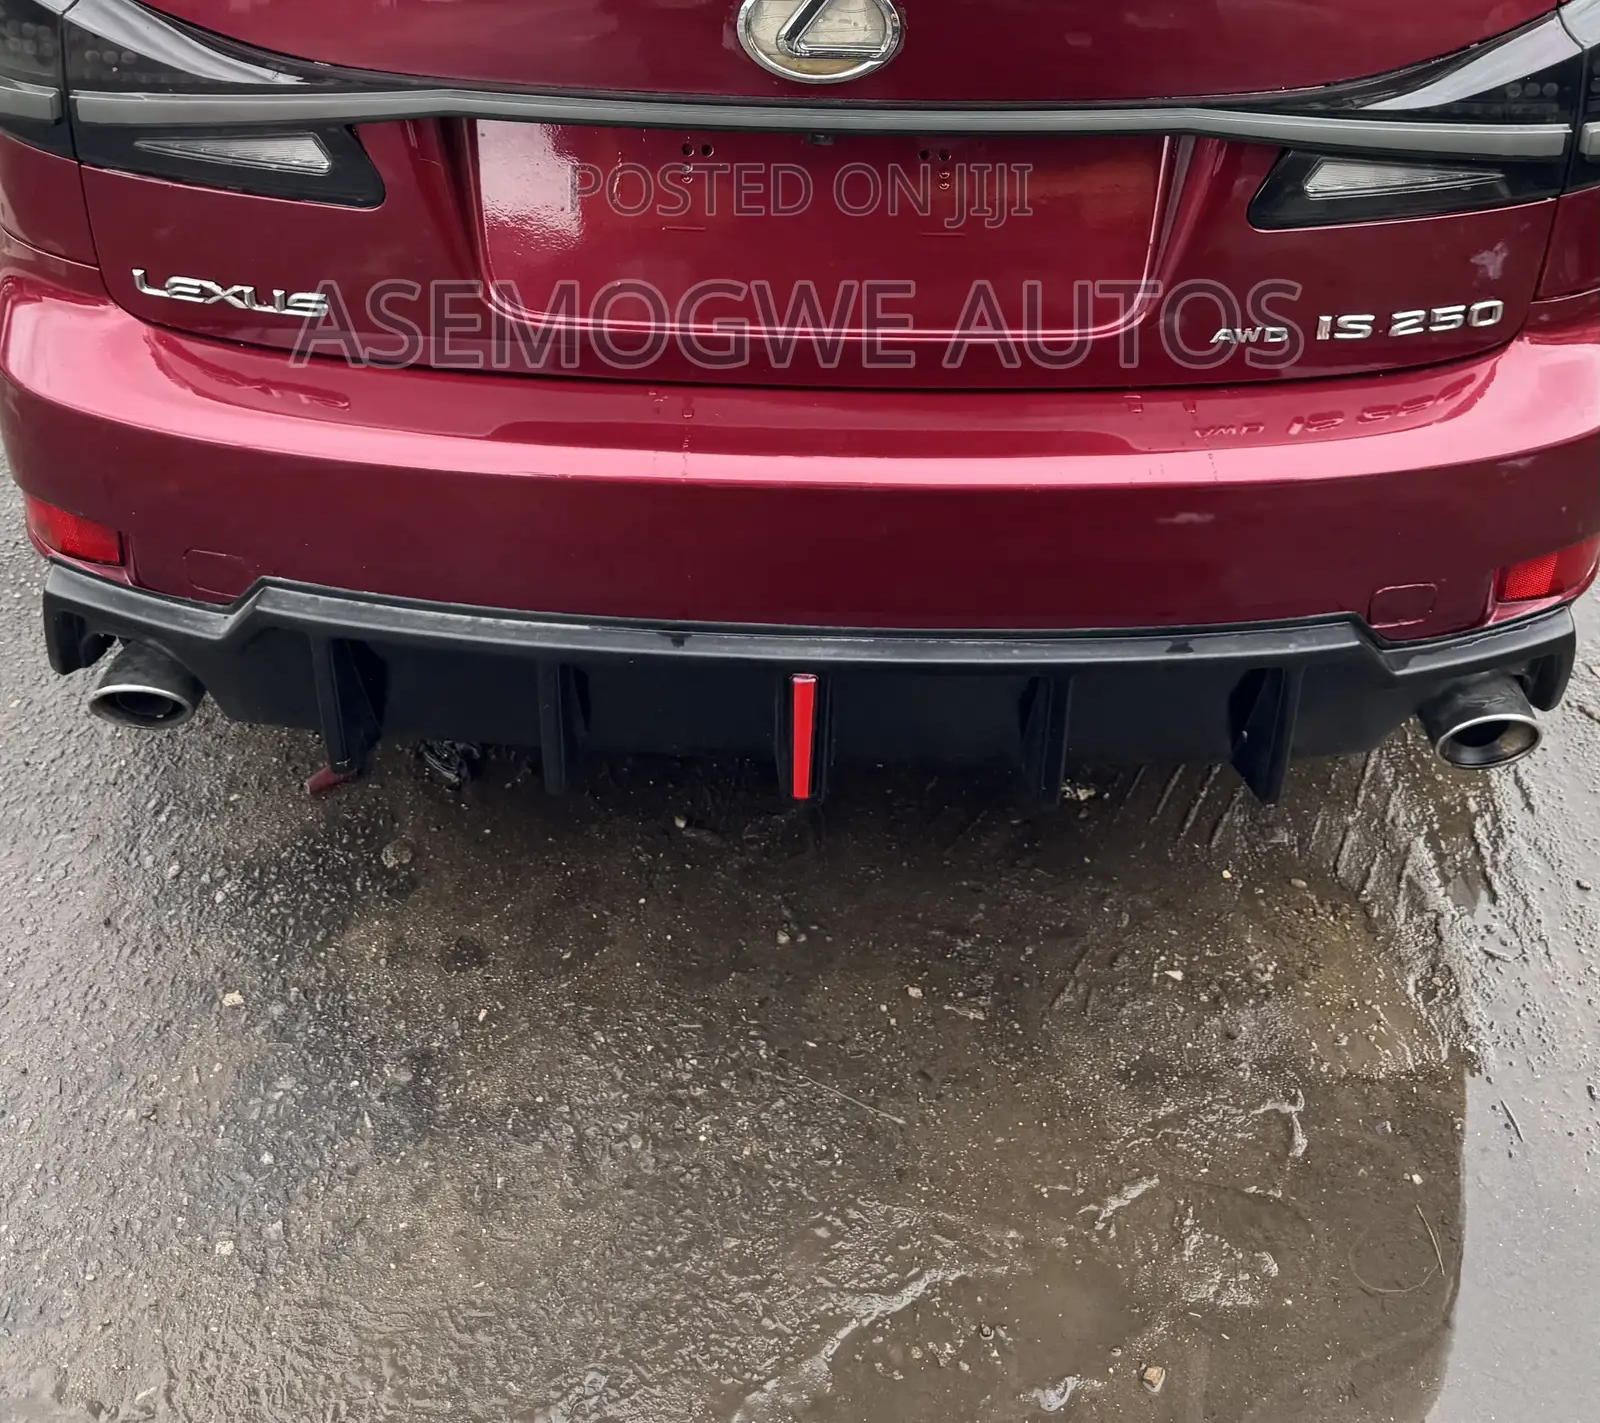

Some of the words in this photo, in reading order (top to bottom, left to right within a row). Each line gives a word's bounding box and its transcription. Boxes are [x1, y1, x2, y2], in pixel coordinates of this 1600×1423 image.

[131, 268, 329, 318] LEXUS
[1209, 326, 1289, 344] AWD
[1316, 314, 1376, 341] IS
[1388, 299, 1505, 337] 250
